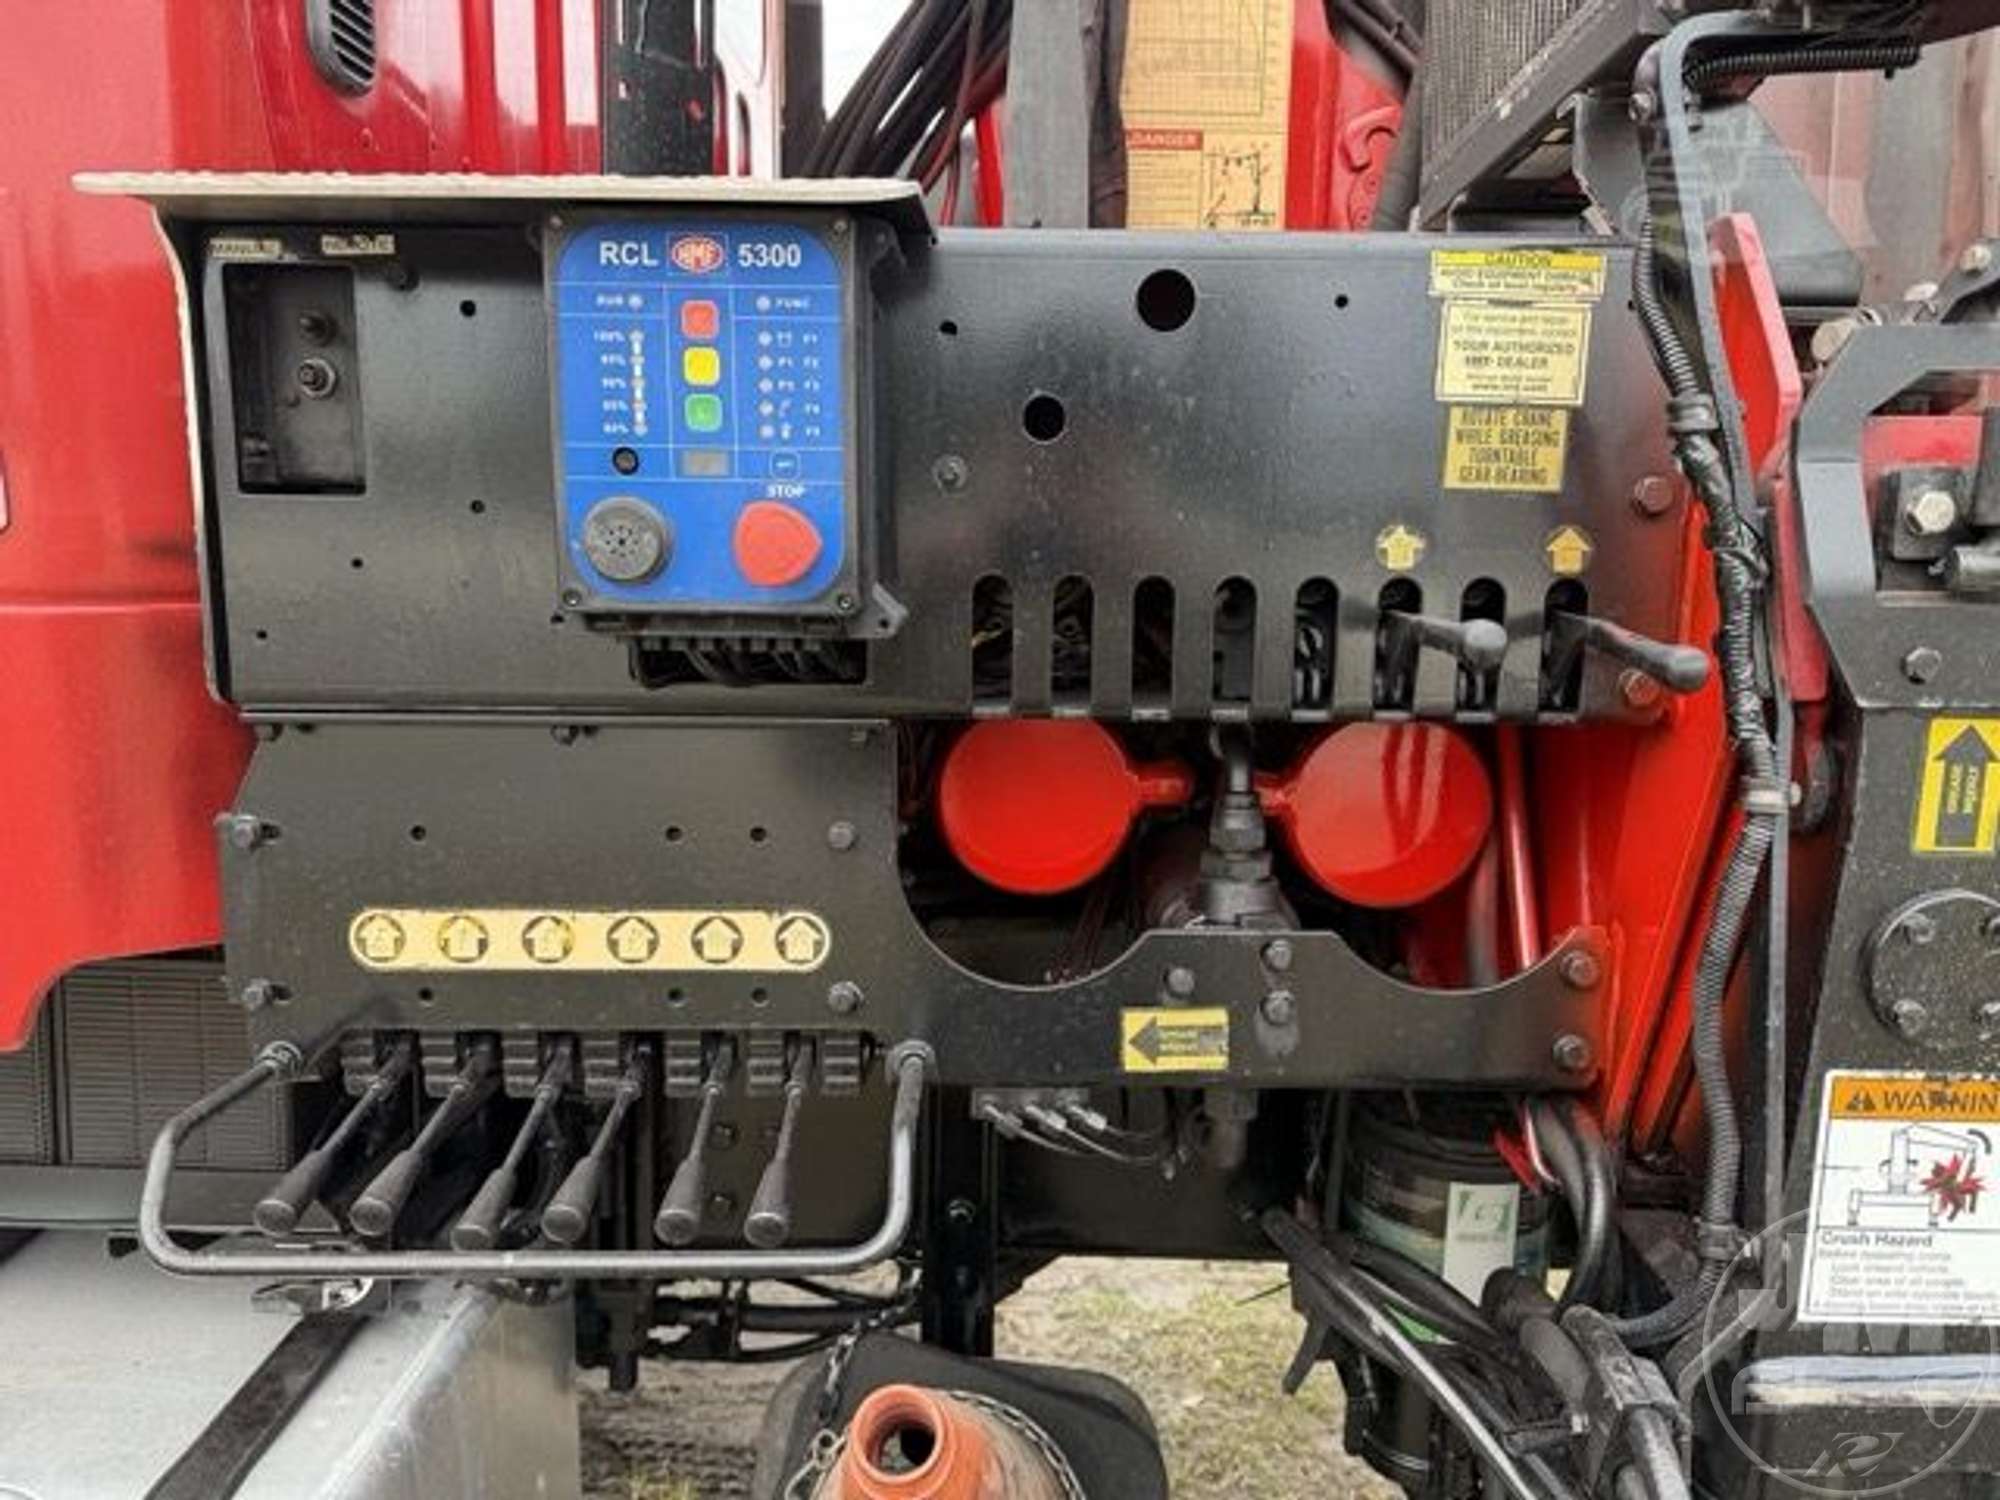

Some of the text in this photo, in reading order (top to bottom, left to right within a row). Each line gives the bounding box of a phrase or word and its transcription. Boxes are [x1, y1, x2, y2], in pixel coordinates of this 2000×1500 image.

[1127, 131, 1197, 147] DANGER
[600, 241, 659, 266] RCL
[737, 243, 802, 268] 5300
[1485, 253, 1552, 268] CAUTION
[1453, 340, 1575, 355] YOUR AUTHORIZED
[1496, 356, 1549, 368] DEALER
[1455, 426, 1560, 448] WHILE GREASING
[1468, 446, 1538, 467] TURNTABLE
[767, 484, 805, 498] STOP
[1821, 1231, 1934, 1248] Crush Hazard
